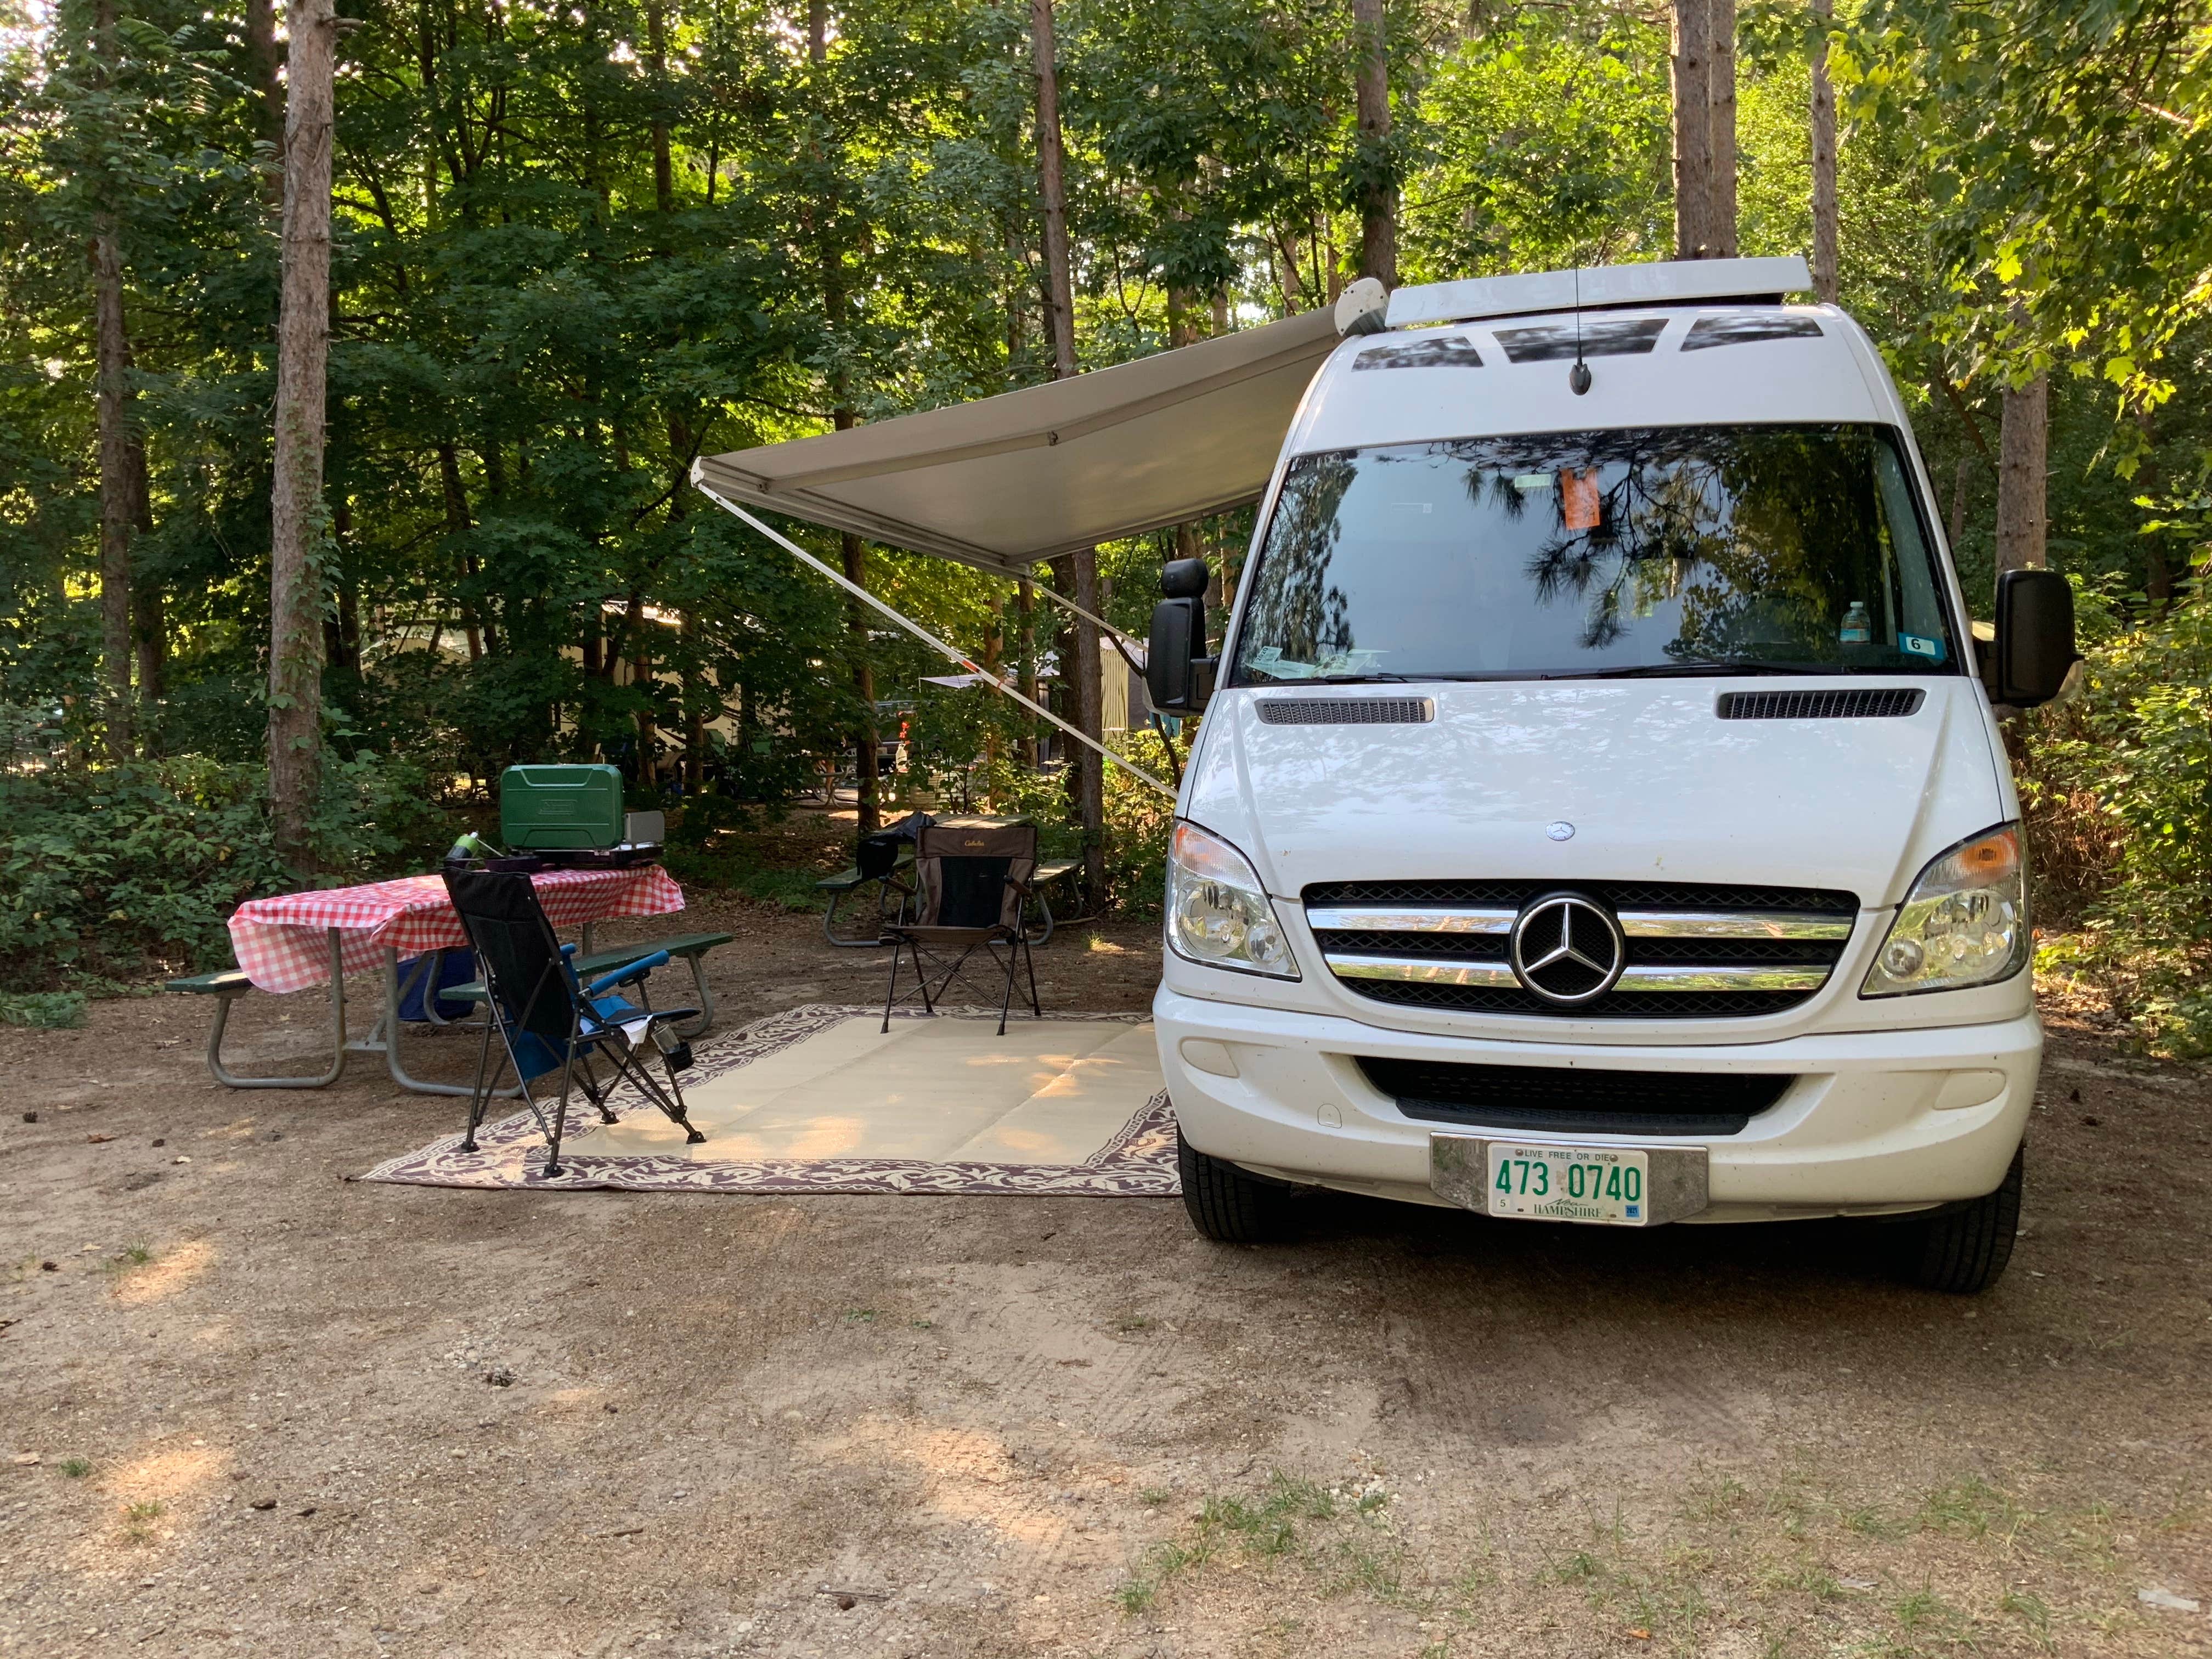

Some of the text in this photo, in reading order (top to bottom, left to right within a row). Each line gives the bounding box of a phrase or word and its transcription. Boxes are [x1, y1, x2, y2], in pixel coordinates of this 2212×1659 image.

[1911, 638, 1921, 650] 6
[1496, 1159, 1640, 1201] 473 0740
[1500, 1199, 1506, 1207] 5
[1545, 1198, 1589, 1206] New
[1534, 1204, 1602, 1218] HAMPSHIRE
